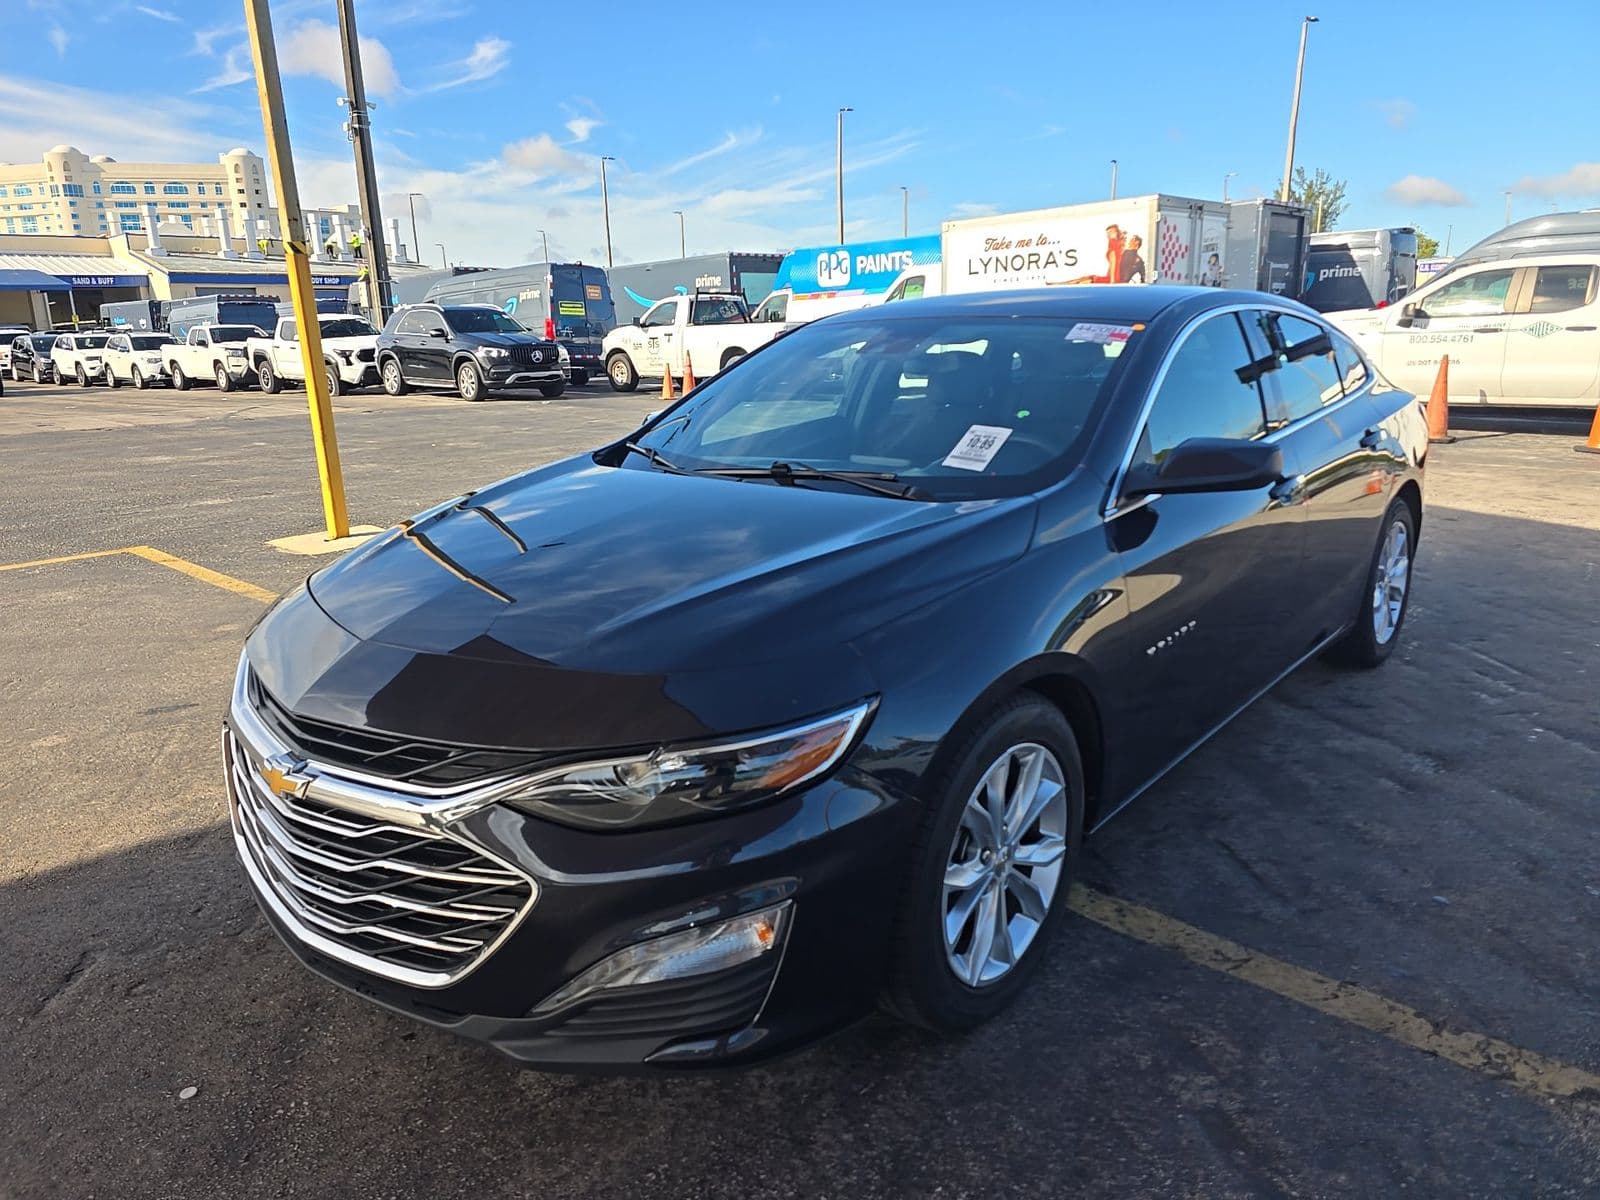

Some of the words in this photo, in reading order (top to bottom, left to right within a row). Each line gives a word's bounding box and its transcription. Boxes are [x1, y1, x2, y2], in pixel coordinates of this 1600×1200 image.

[984, 236, 1012, 252] Take
[1015, 239, 1032, 249] me
[818, 251, 850, 282] PPG
[856, 251, 912, 275] PAINTS
[968, 248, 1078, 275] LYNORA'S
[72, 277, 90, 285] SAND
[695, 273, 722, 288] prime
[1319, 265, 1361, 281] prime
[519, 288, 541, 304] prime
[1524, 322, 1559, 337] MILLER
[647, 336, 660, 350] STS
